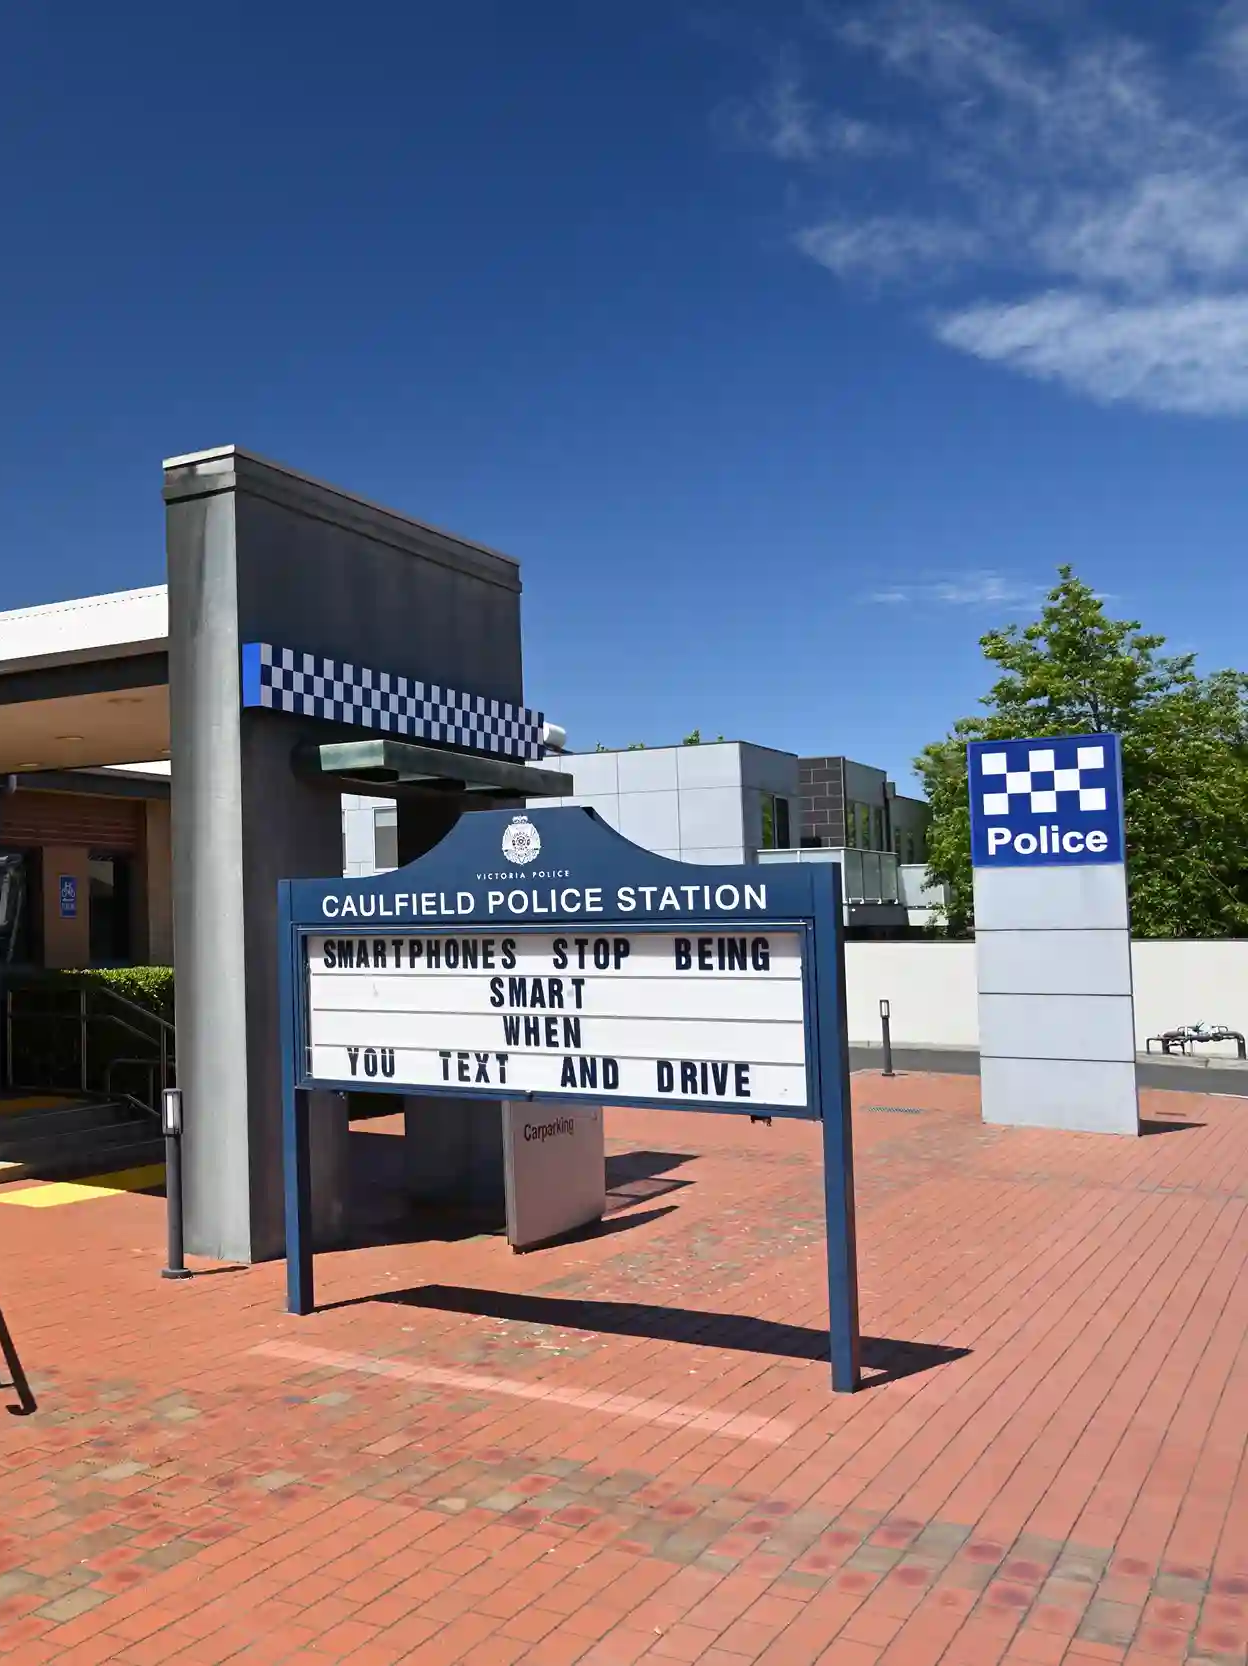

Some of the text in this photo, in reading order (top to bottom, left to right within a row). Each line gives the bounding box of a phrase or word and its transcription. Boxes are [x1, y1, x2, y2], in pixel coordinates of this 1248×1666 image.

[987, 825, 1108, 855] Police
[476, 870, 571, 880] VICTORIA POLICE
[322, 884, 767, 918] CAULFIELD POLICE STATION
[323, 937, 770, 971] SMARTPHONES STOP BEING
[489, 976, 585, 1009] SMART
[502, 1015, 582, 1049] WHEN
[347, 1047, 752, 1097] YOU TEXT AND DRIVE
[524, 1116, 574, 1142] Carparking
